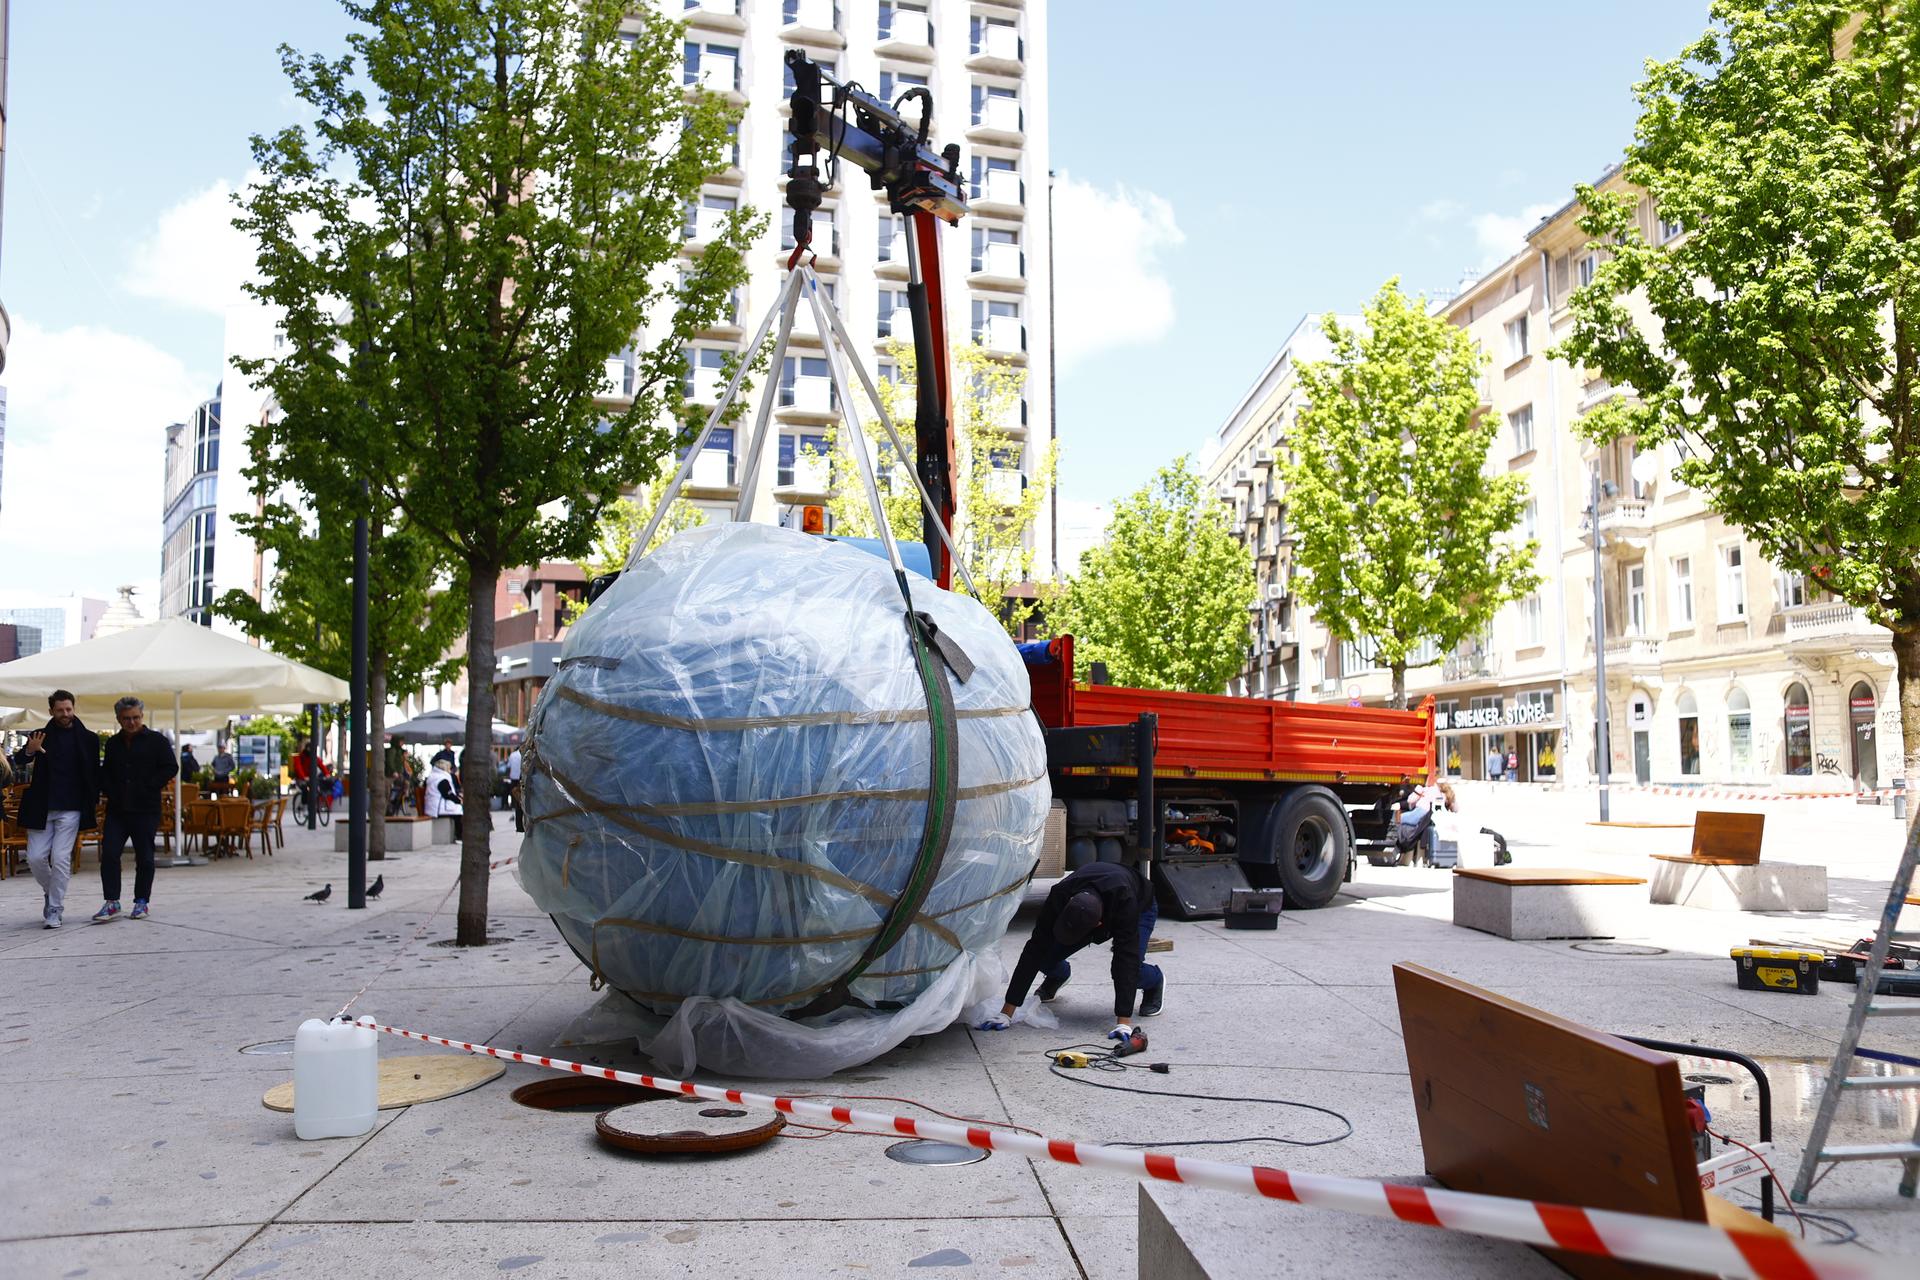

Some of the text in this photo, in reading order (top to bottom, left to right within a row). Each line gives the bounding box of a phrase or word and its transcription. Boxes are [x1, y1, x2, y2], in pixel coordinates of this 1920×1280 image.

[1435, 702, 1542, 729] AW SNEAKER STORE
